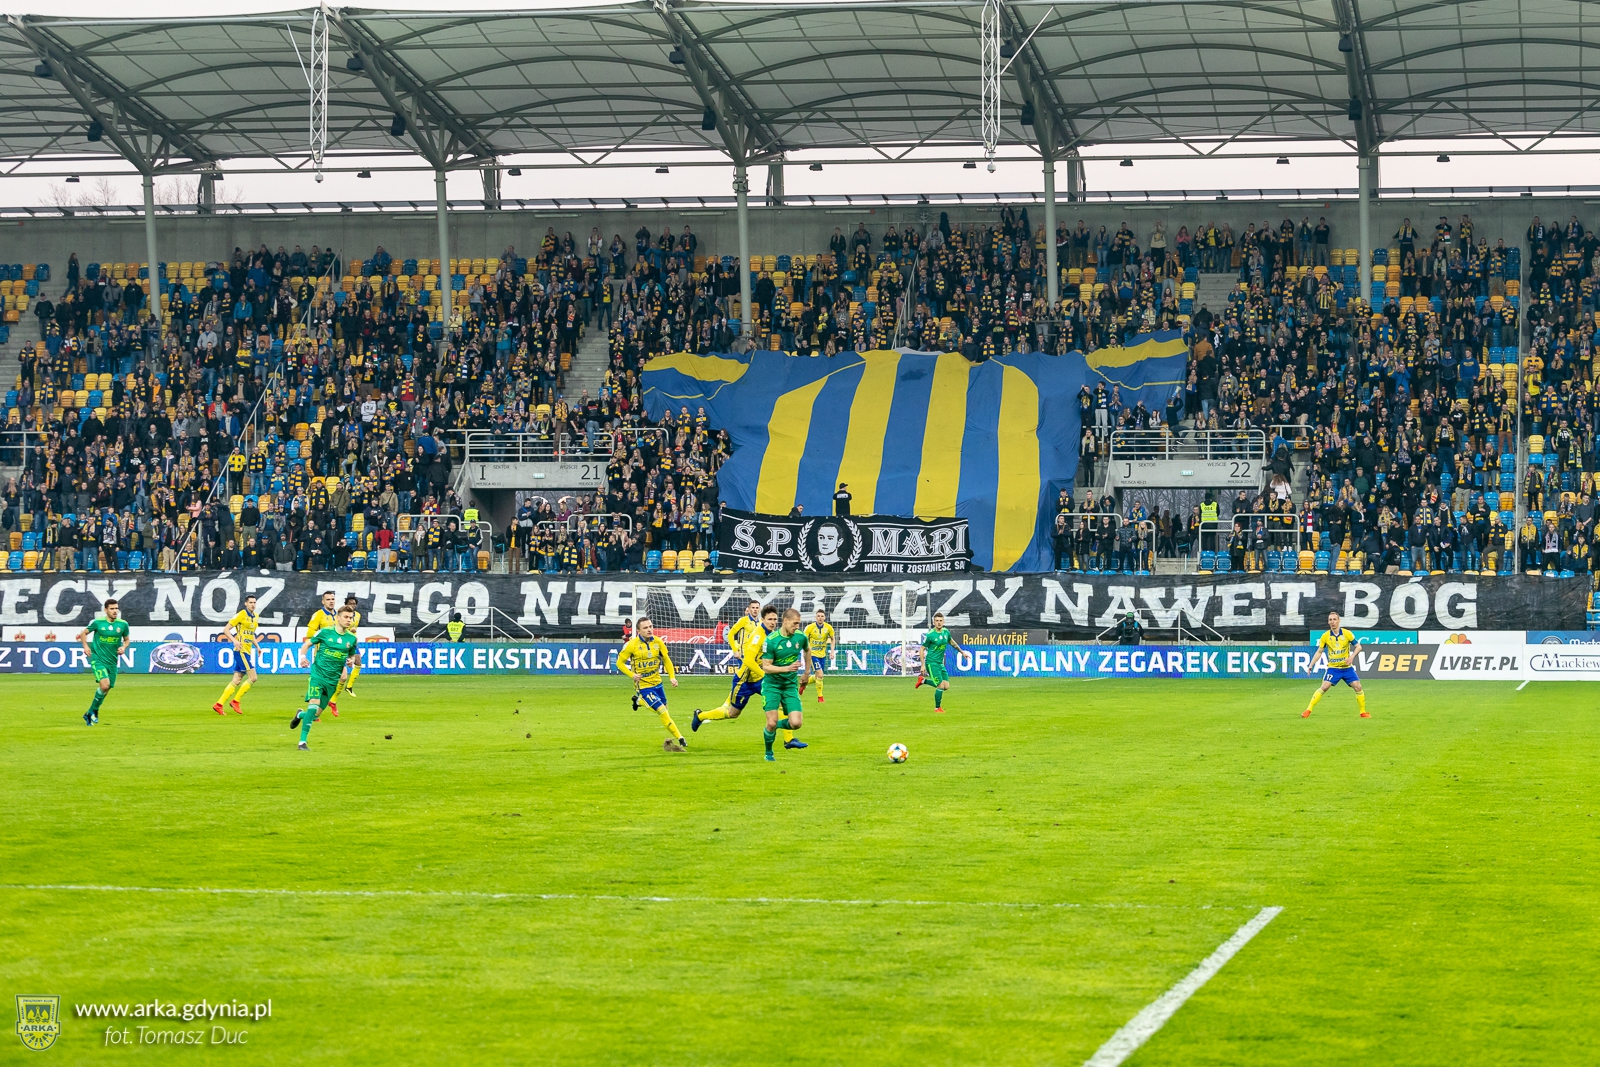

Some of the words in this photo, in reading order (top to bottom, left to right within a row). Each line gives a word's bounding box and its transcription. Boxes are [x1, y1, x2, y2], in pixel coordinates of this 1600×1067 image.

[479, 465, 487, 480] I
[581, 465, 601, 480] 21
[1123, 463, 1132, 478] J
[1230, 462, 1251, 478] 22
[731, 519, 793, 557] Ś.P.
[867, 524, 968, 558] MARI
[738, 559, 784, 571] 30.03.2003
[864, 563, 888, 573] NIGDY
[891, 563, 905, 573] NIE
[907, 561, 952, 573] ZOSTANIESZ
[316, 581, 490, 625] TEGO
[517, 581, 648, 625] NIE
[665, 576, 1023, 627] WYBACZY
[1040, 578, 1316, 629] NAWET
[1338, 576, 1478, 630] BÓG
[956, 651, 1090, 677] OFICJALNY
[1098, 651, 1220, 673] ZEGAREK
[1439, 656, 1519, 671] LVBET.PL
